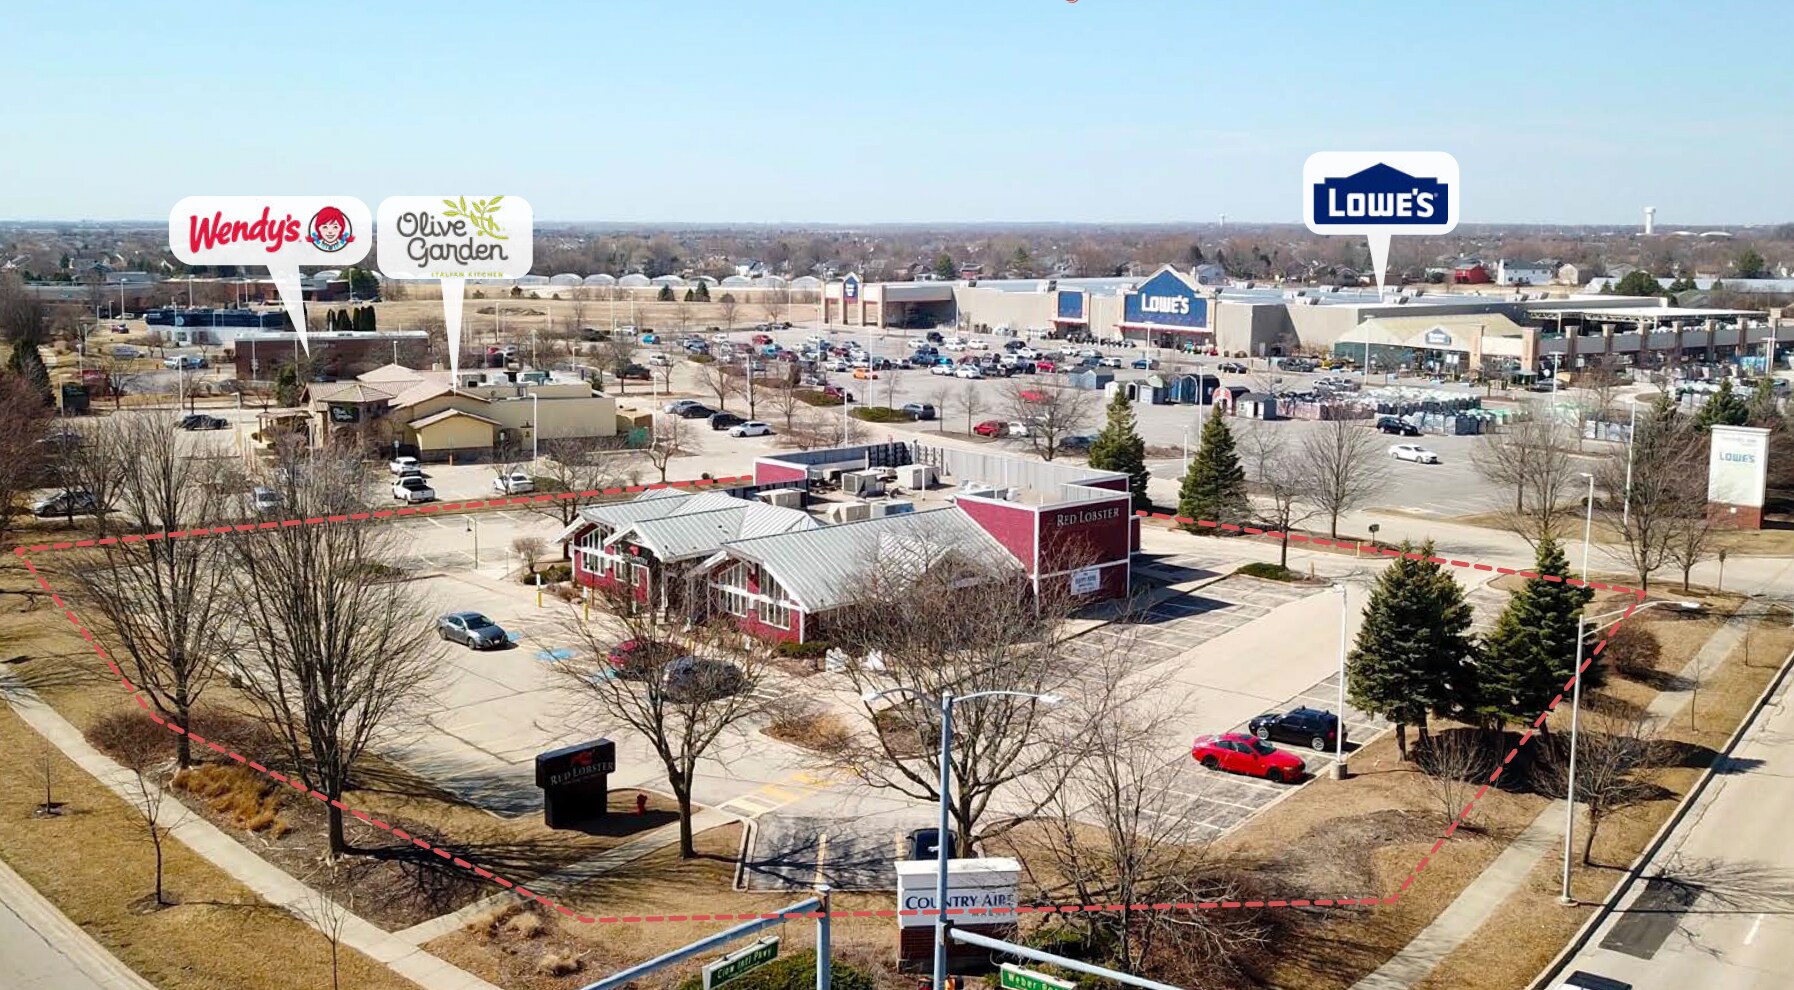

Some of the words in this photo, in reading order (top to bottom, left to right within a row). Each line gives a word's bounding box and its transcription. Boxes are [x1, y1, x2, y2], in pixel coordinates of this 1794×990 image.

[1141, 293, 1190, 314] LOWE'S
[1057, 514, 1077, 526] RED
[1079, 507, 1119, 523] LOBSTER
[550, 773, 571, 785] RED
[572, 762, 613, 777] LOBSTER
[1007, 972, 1038, 990] Weber
